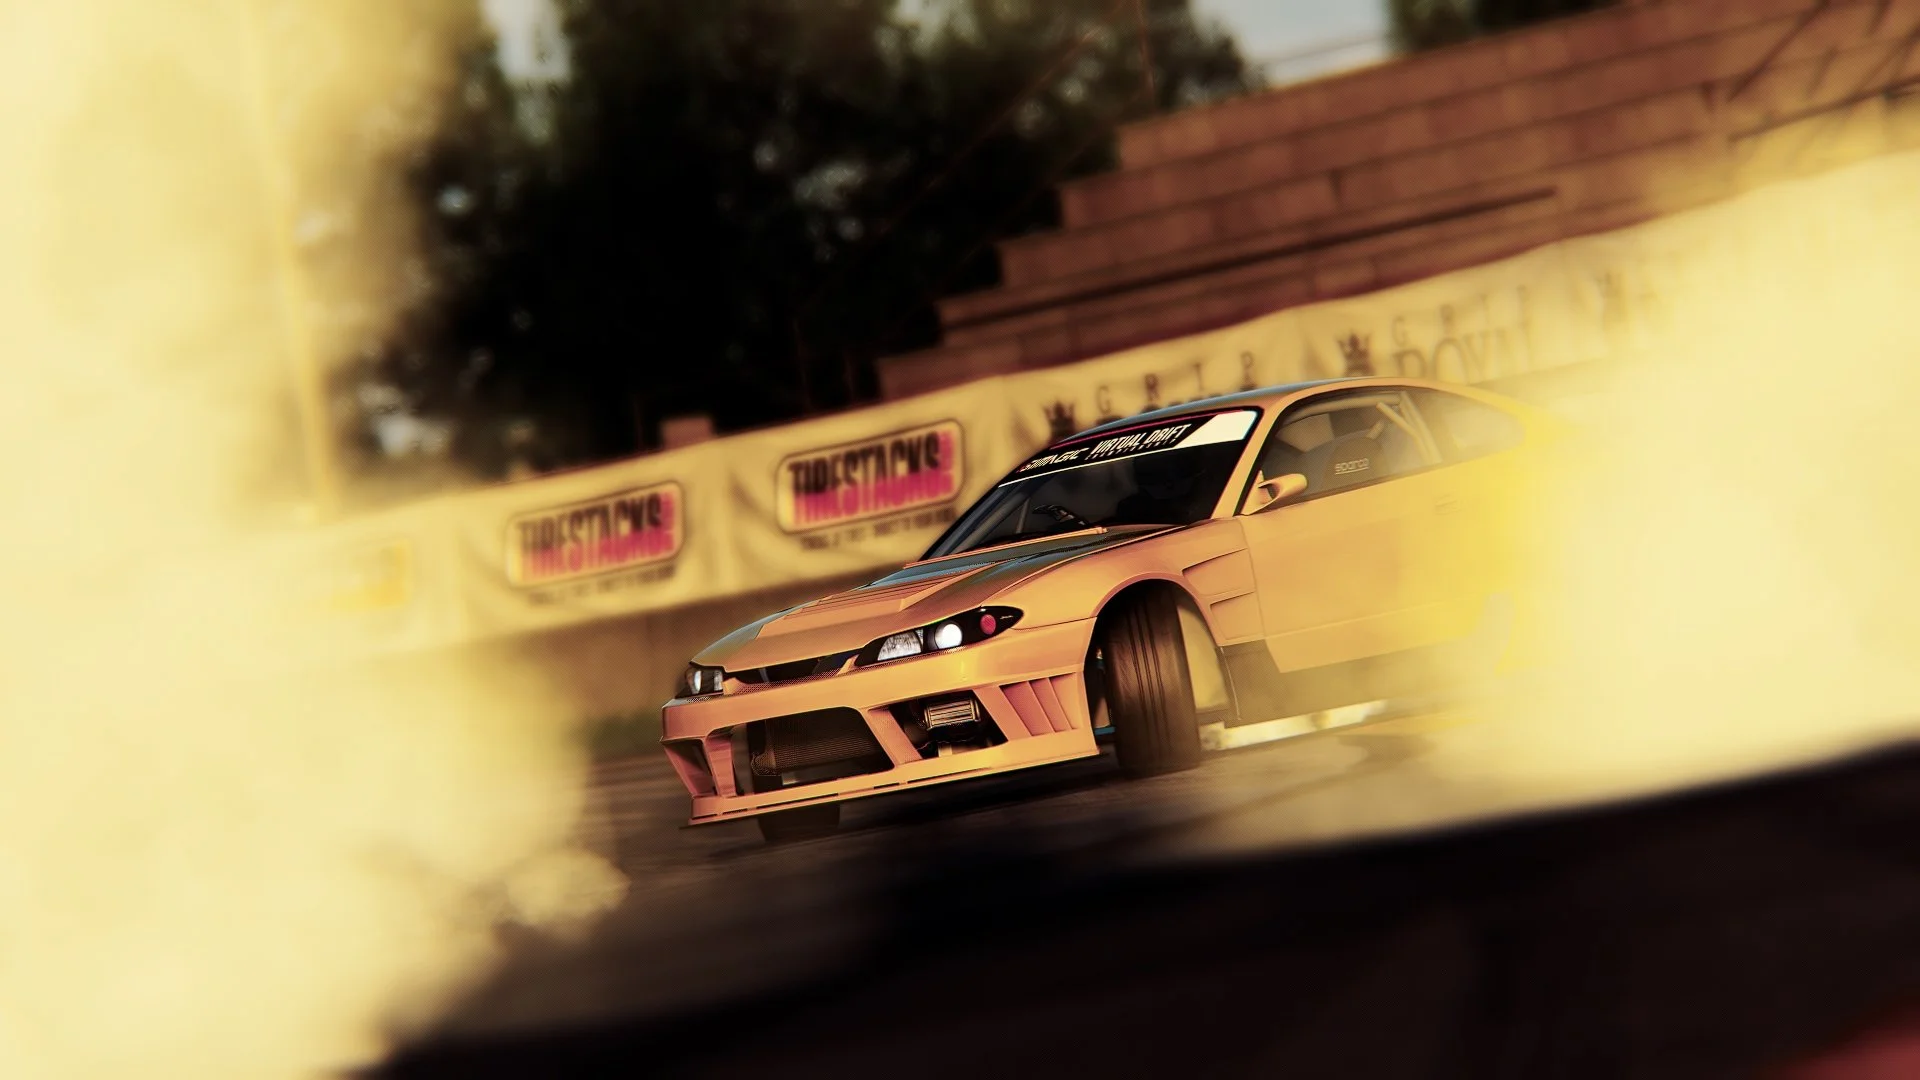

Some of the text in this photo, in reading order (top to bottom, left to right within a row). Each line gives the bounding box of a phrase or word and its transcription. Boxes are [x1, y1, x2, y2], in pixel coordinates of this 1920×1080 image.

[1090, 432, 1147, 455] VIRTUAL
[1145, 424, 1191, 445] DRIFT
[788, 431, 942, 525] TIRESTACKS
[1335, 458, 1369, 473] sparco
